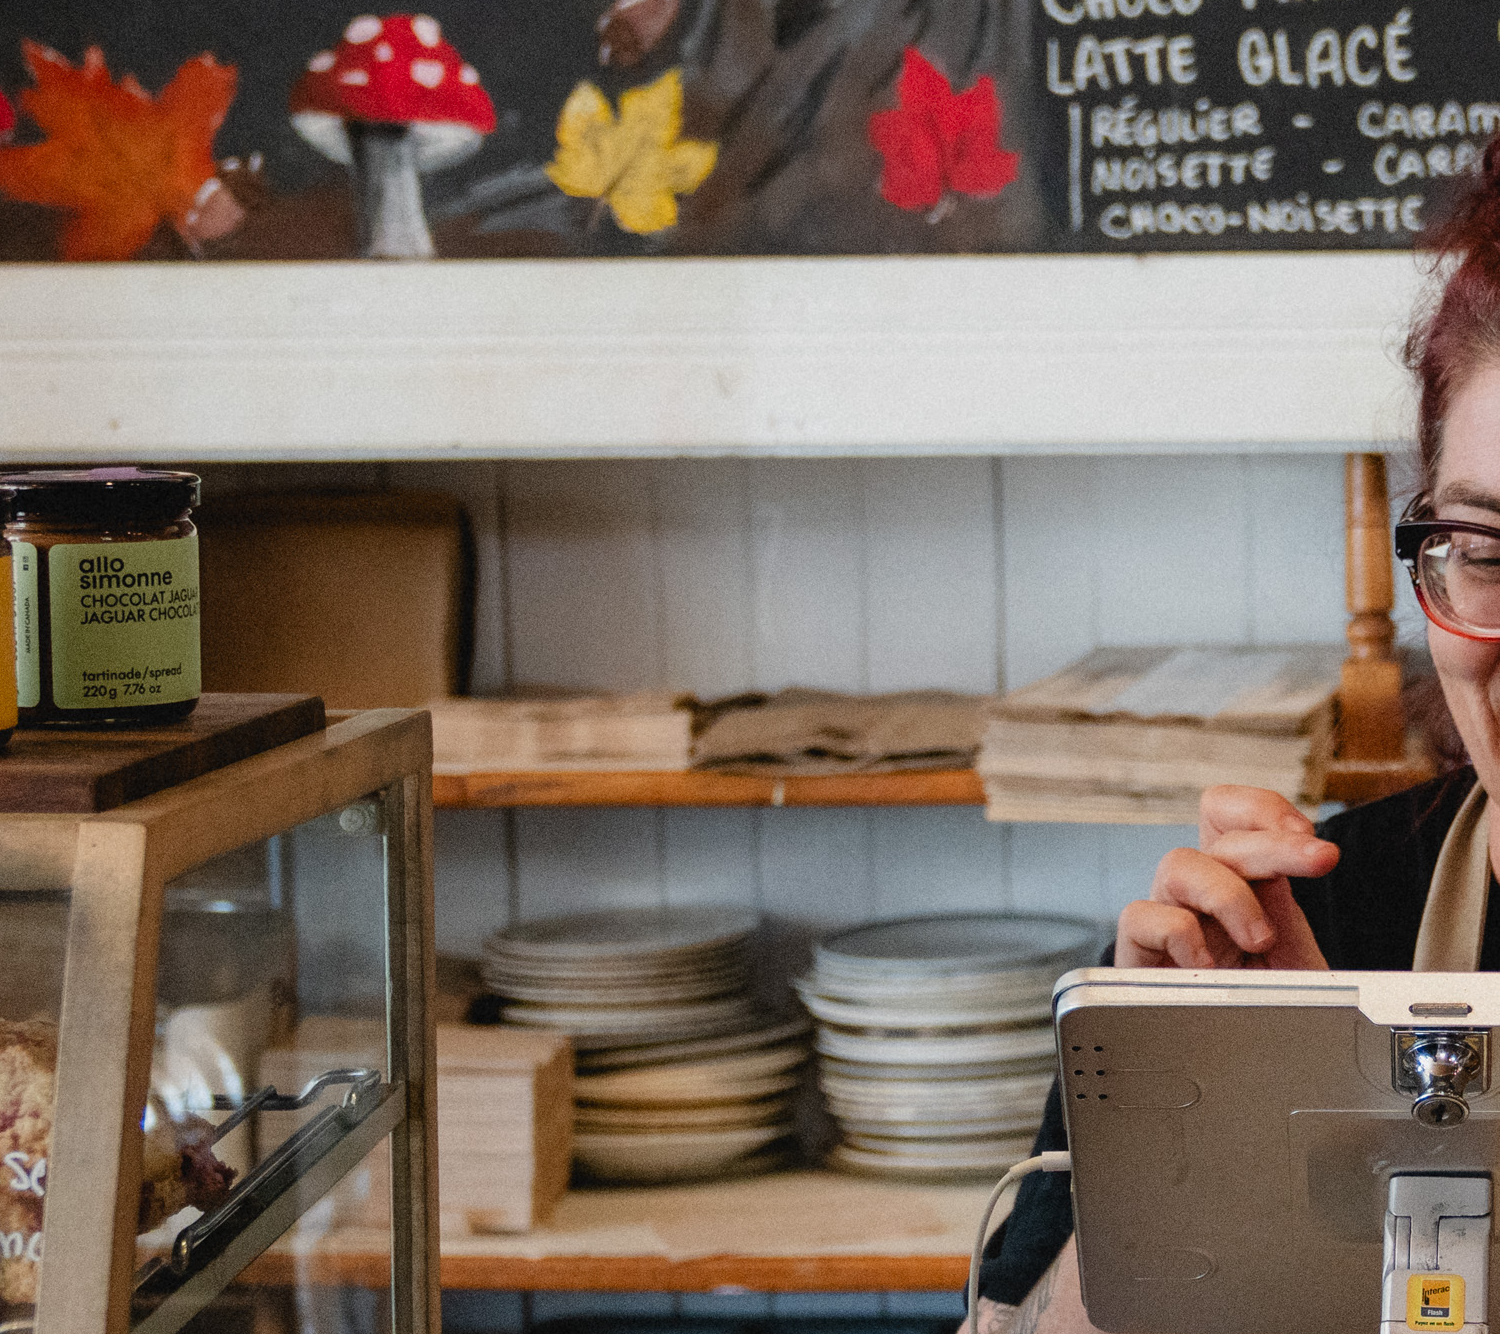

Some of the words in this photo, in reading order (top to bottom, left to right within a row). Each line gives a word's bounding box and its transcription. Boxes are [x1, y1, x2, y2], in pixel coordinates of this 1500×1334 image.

[1046, 33, 1199, 95] LATTE
[1238, 10, 1417, 88] GLACÉ
[1091, 147, 1275, 195] NOISETTE
[1374, 141, 1484, 186] CARA
[79, 557, 124, 573] allo
[80, 571, 173, 589] simonne
[80, 591, 166, 608] CHOCOLAT
[80, 609, 146, 625] JAGUAR
[149, 603, 198, 622] CHOCOLA
[149, 684, 162, 694] oz
[1422, 1286, 1450, 1296] Interac
